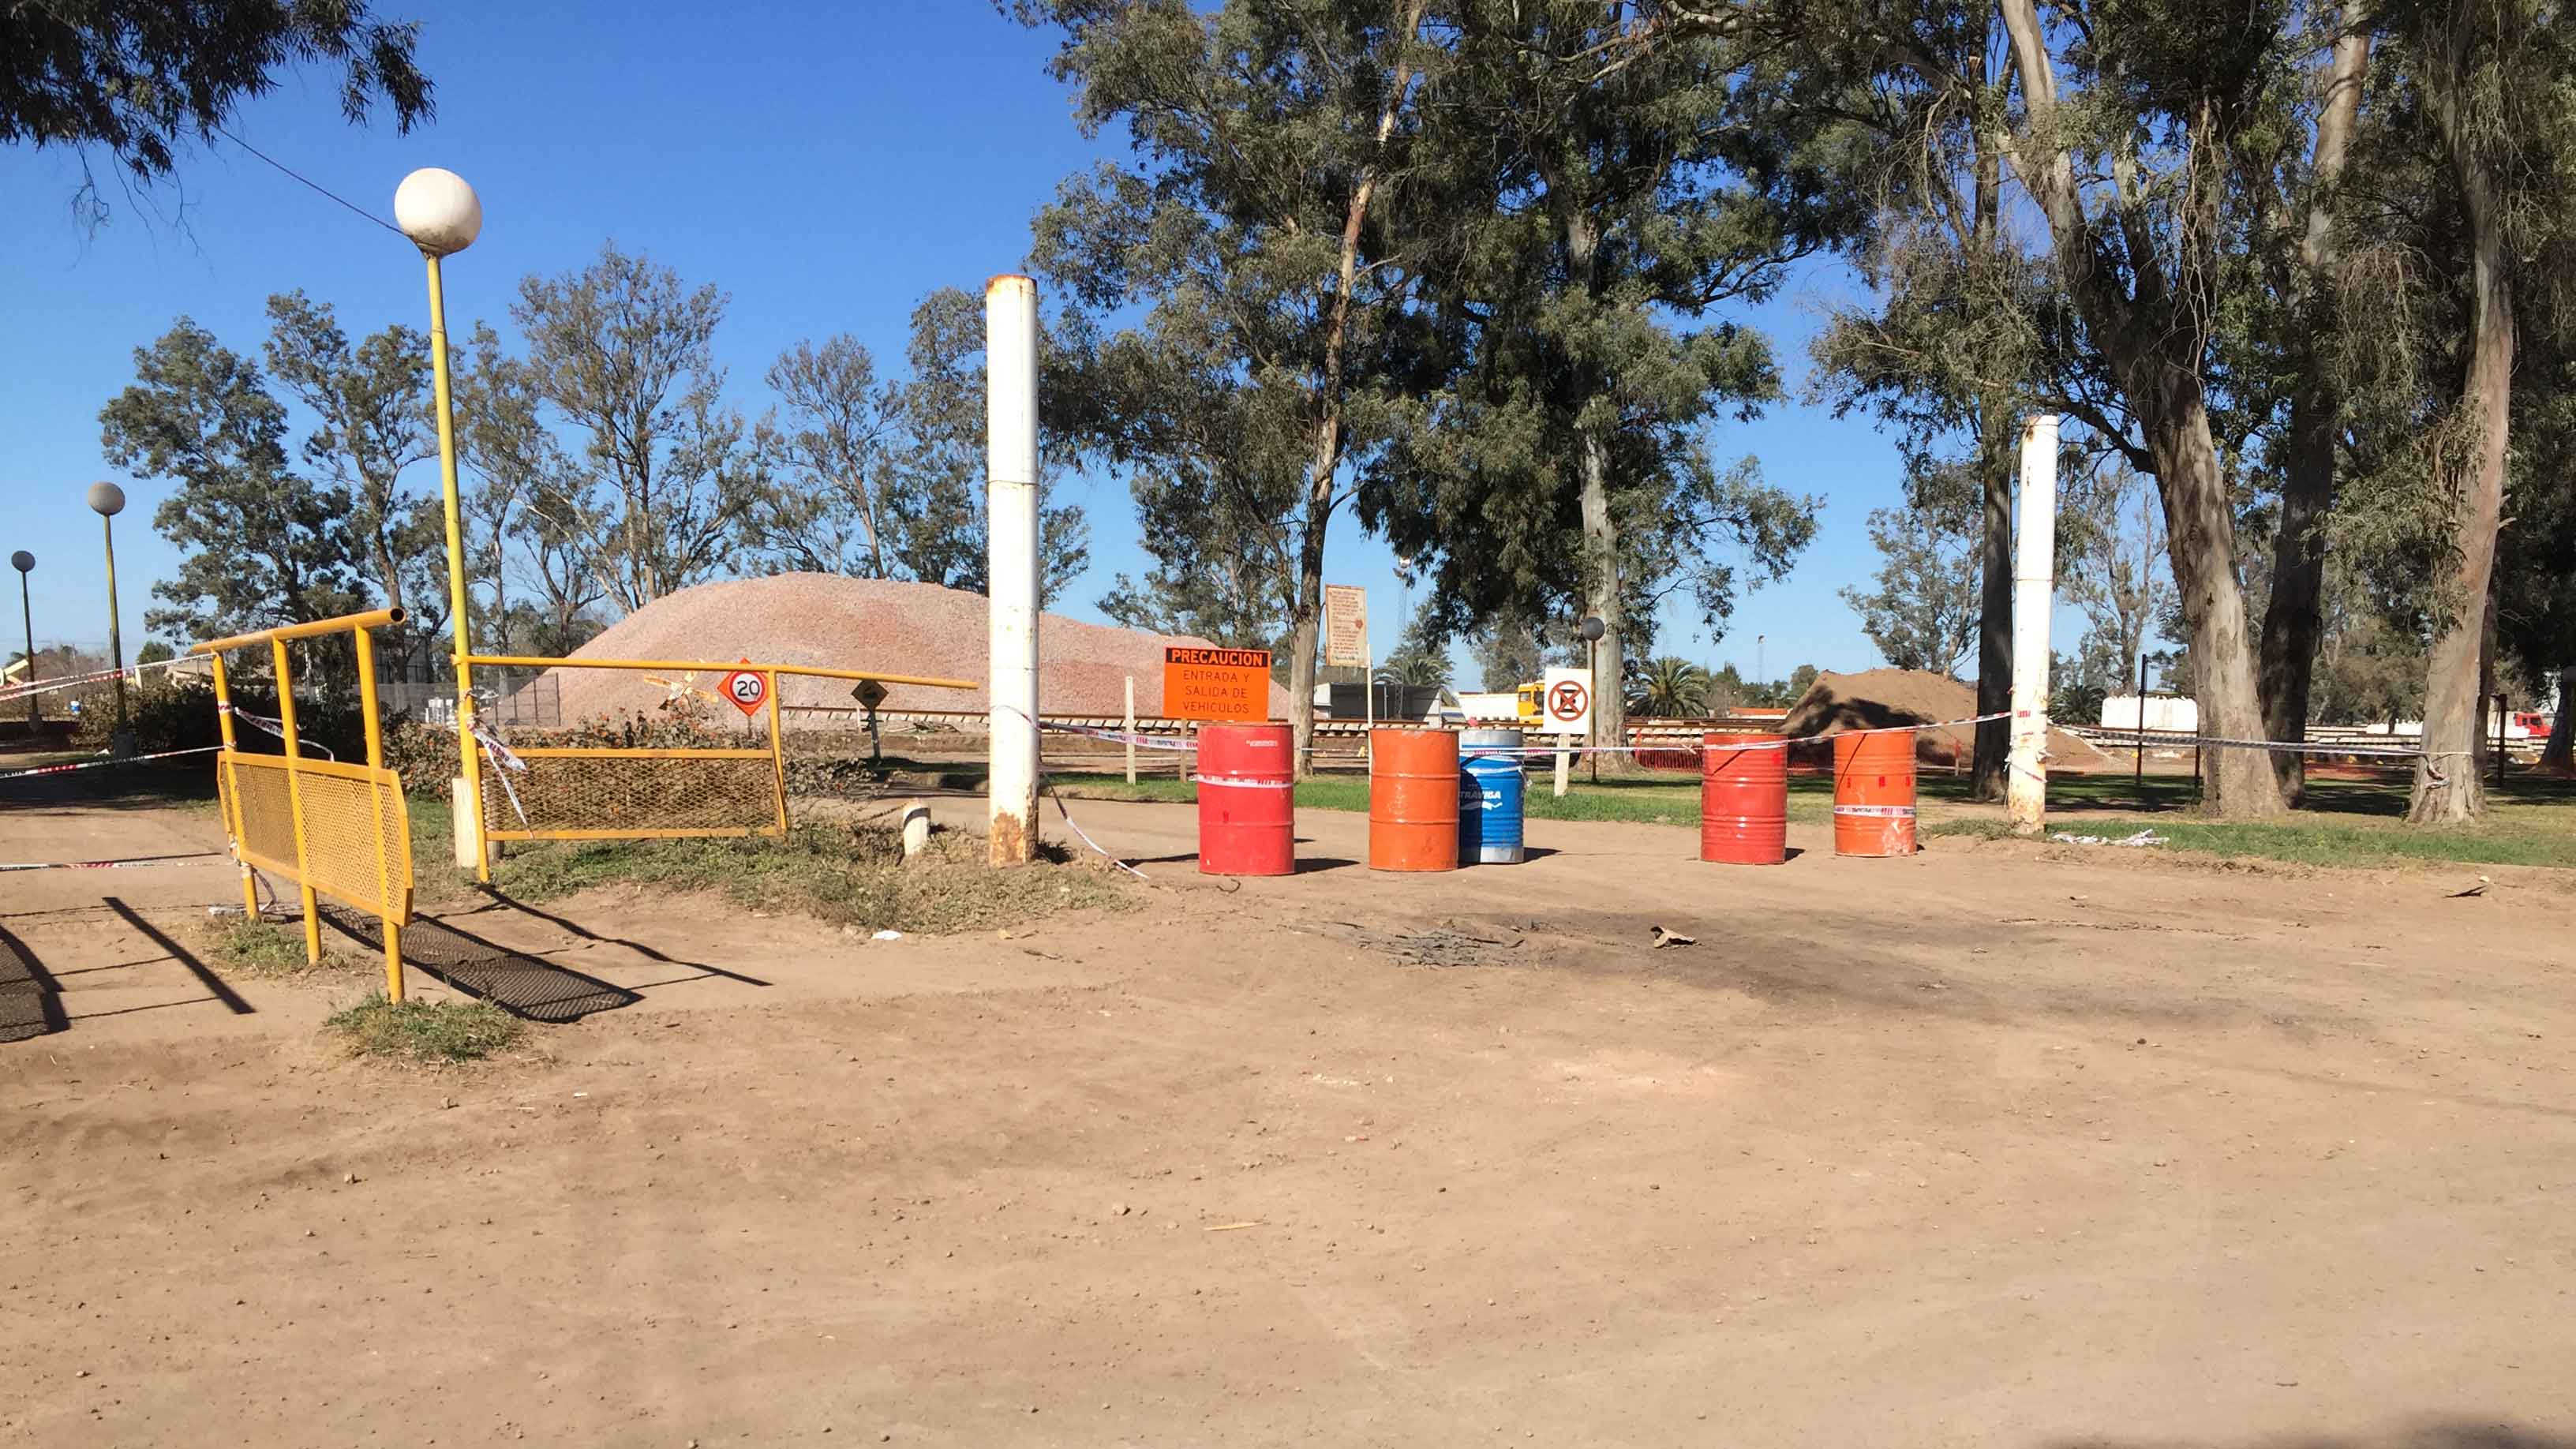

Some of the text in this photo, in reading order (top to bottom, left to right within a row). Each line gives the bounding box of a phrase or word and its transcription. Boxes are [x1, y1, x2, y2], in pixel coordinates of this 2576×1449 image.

[1171, 649, 1263, 666] PRECAUCION
[1183, 670, 1250, 683] ENTRADA Y
[736, 680, 760, 697] 20
[1185, 685, 1249, 698] SALIDA DE
[1182, 701, 1249, 714] VEHICULOS
